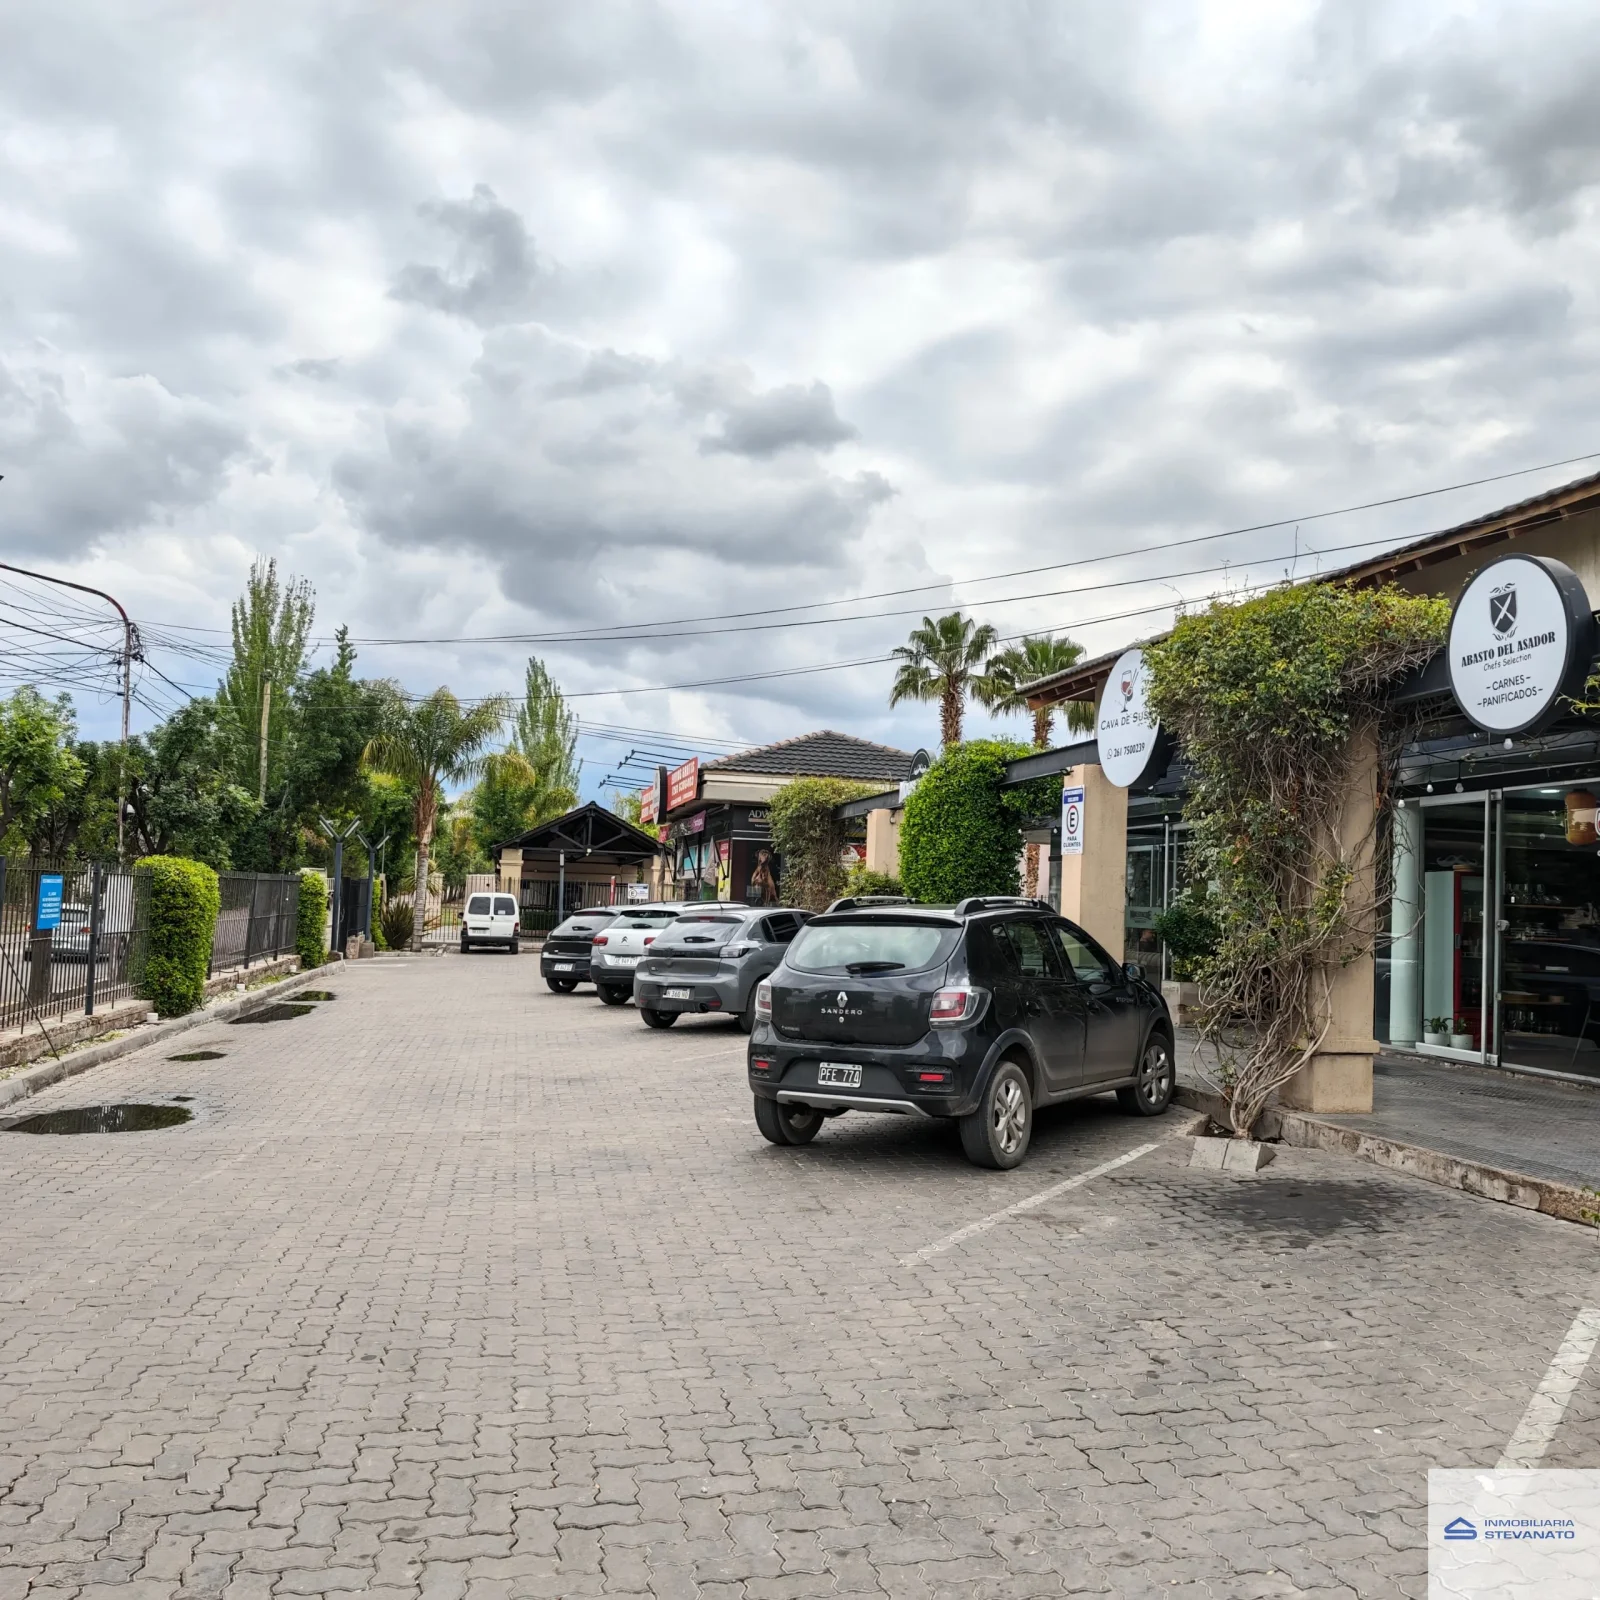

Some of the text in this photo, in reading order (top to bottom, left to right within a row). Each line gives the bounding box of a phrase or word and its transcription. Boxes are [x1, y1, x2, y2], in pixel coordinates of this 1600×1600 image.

[1461, 631, 1556, 667] ABASTO DEL ASADOR
[1483, 653, 1532, 671] Chefs Selection
[1100, 711, 1150, 731] CAVA DE SUS
[1113, 742, 1146, 758] 261 7500239
[1069, 812, 1076, 828] E
[820, 1008, 863, 1016] SANDERO
[820, 1067, 860, 1083] PFE 774
